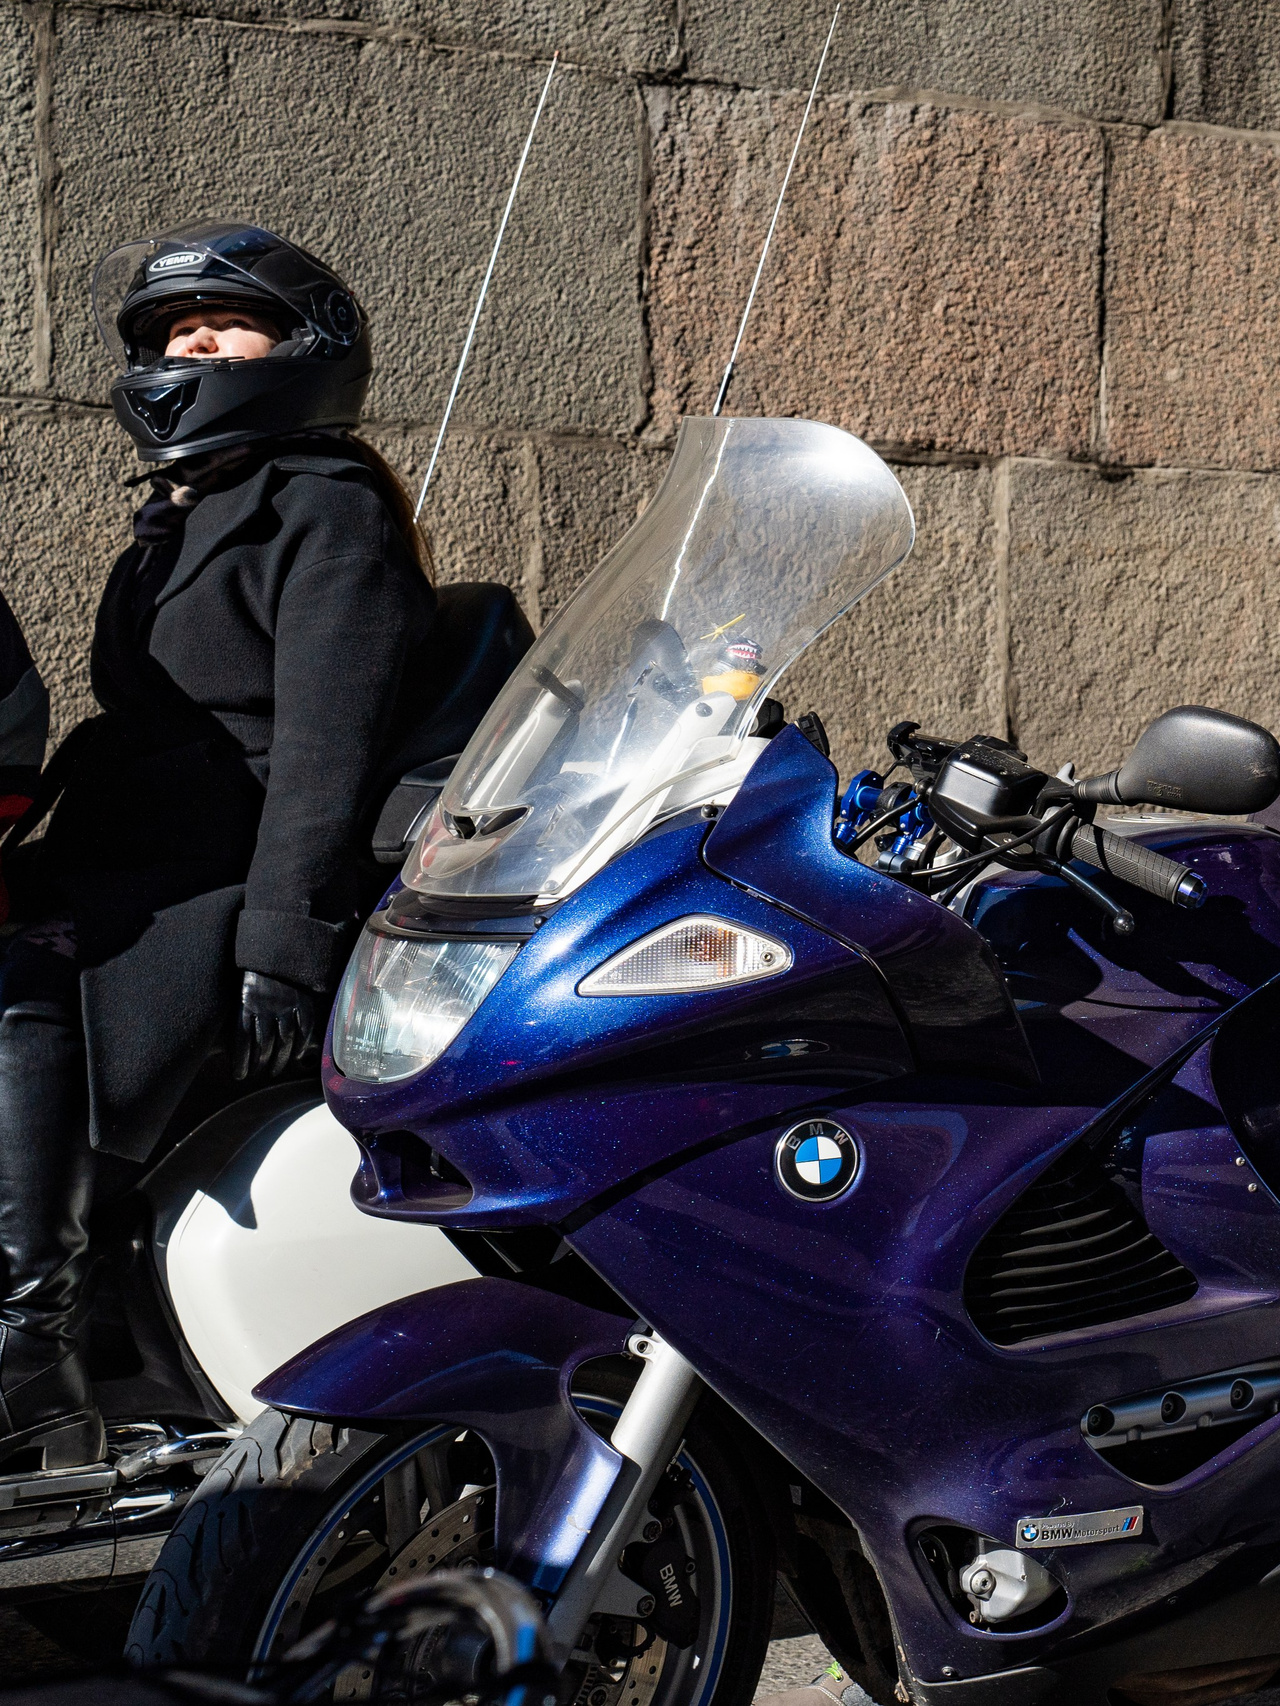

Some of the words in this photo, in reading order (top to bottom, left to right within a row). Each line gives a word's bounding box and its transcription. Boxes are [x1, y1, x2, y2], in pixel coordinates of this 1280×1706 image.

[786, 1123, 848, 1150] BMW
[1041, 1528, 1073, 1540] BMW
[1074, 1525, 1119, 1538] Motorsport
[660, 1563, 682, 1607] BMW
